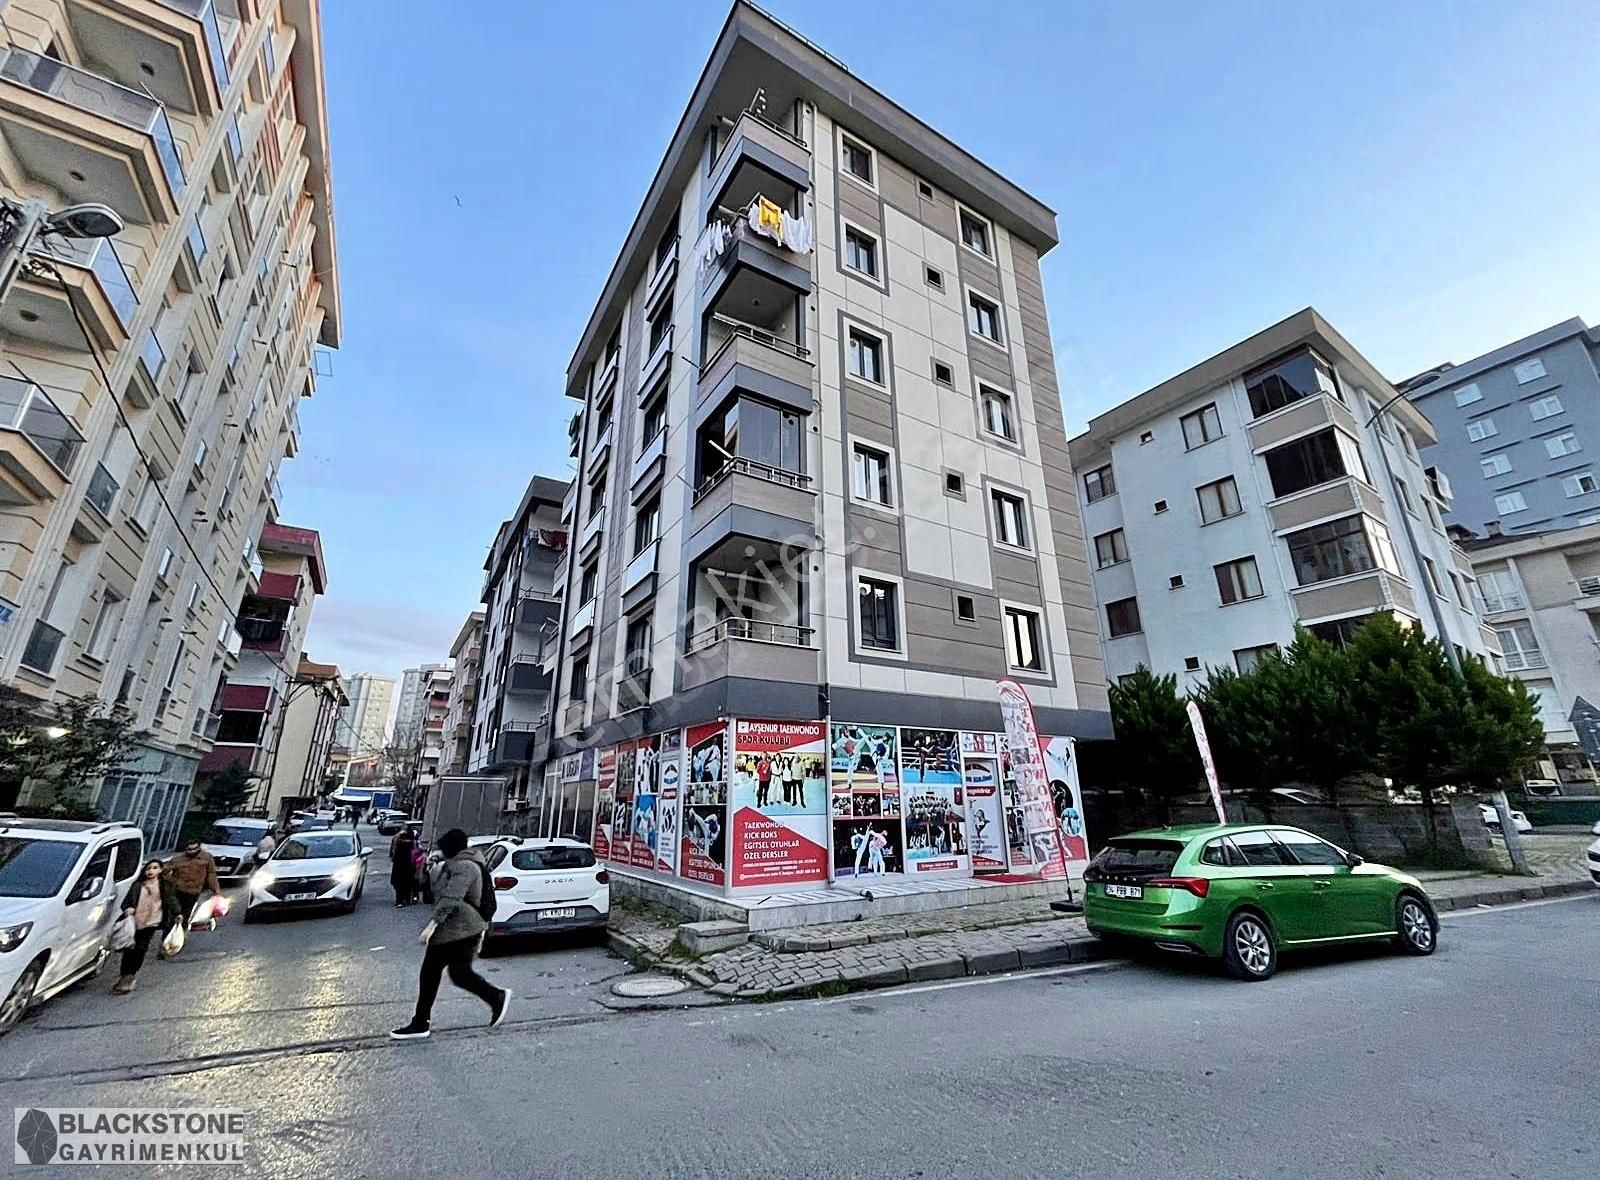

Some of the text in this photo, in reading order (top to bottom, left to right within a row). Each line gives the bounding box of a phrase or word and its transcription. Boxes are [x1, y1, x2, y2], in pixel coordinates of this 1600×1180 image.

[749, 723, 820, 736] AYŞENUR TAEKWONDO
[737, 735, 758, 744] SPOR
[770, 840, 800, 849] OYUNLAR
[762, 851, 789, 859] DERSLER
